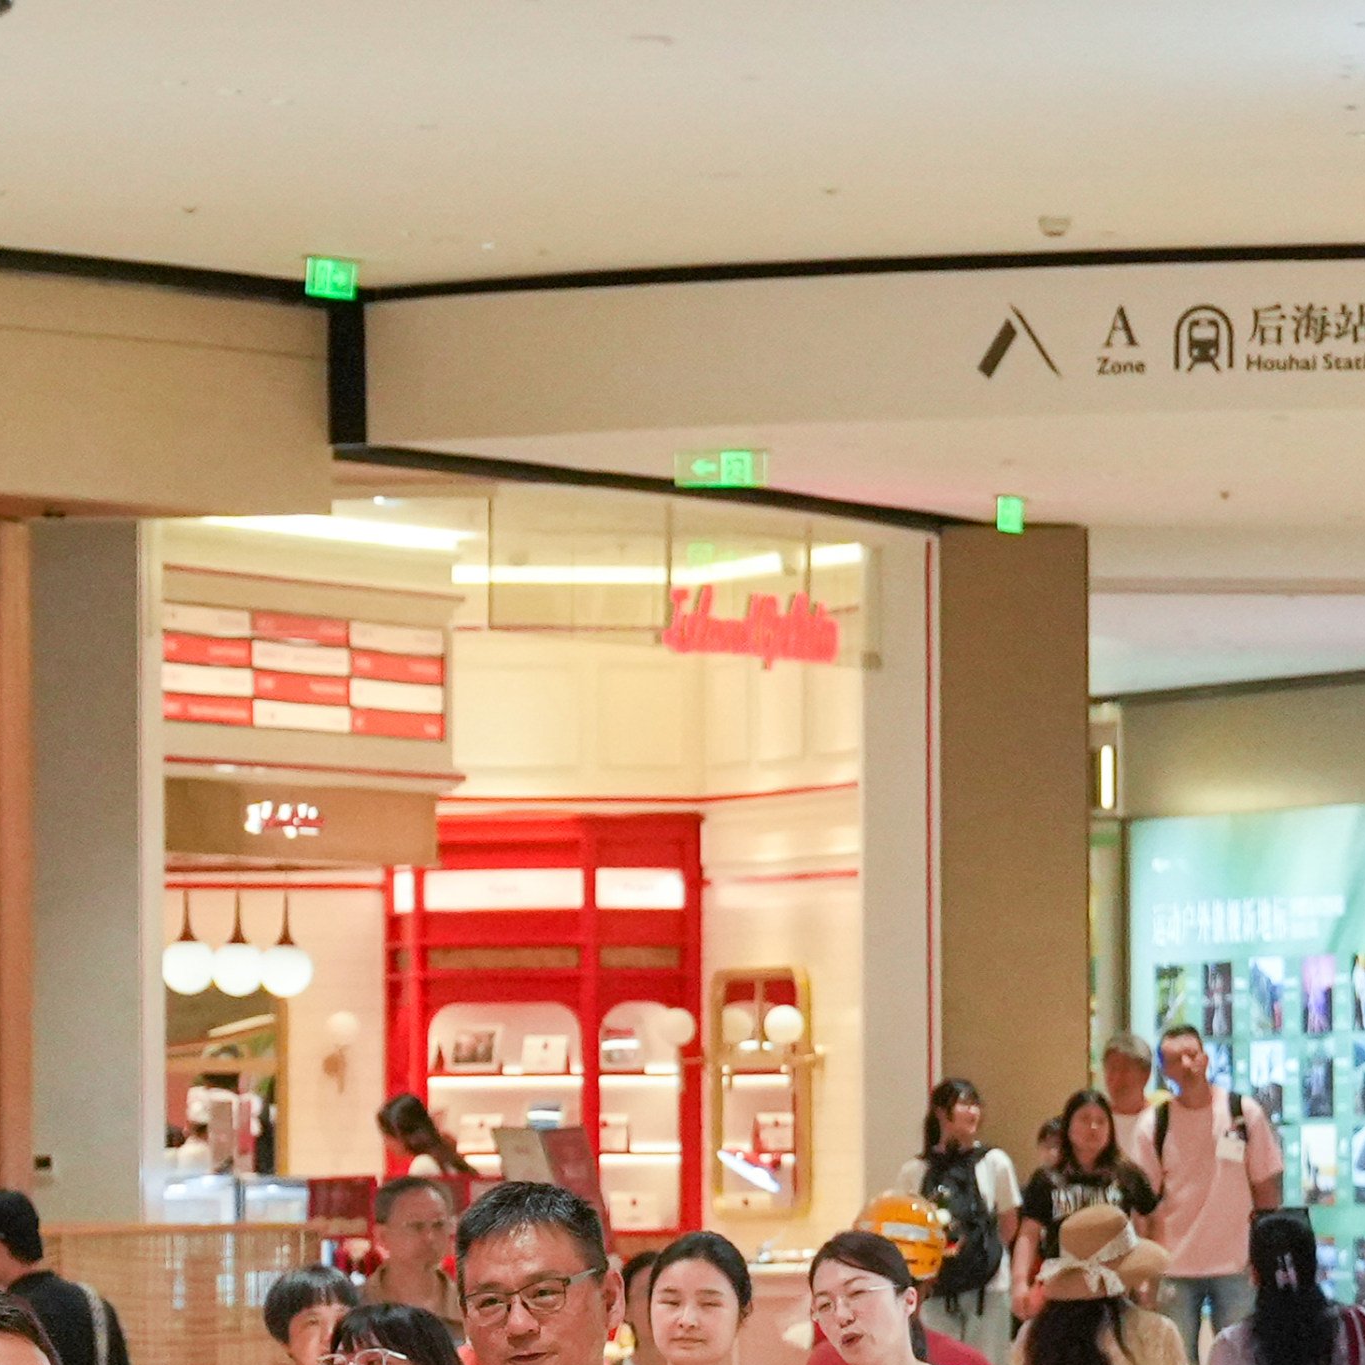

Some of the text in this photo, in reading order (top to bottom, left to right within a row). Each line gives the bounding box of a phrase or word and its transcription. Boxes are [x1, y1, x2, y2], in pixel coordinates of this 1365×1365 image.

[1104, 303, 1139, 348] A
[1096, 356, 1146, 375] Zone
[1245, 352, 1317, 372] Houhai
